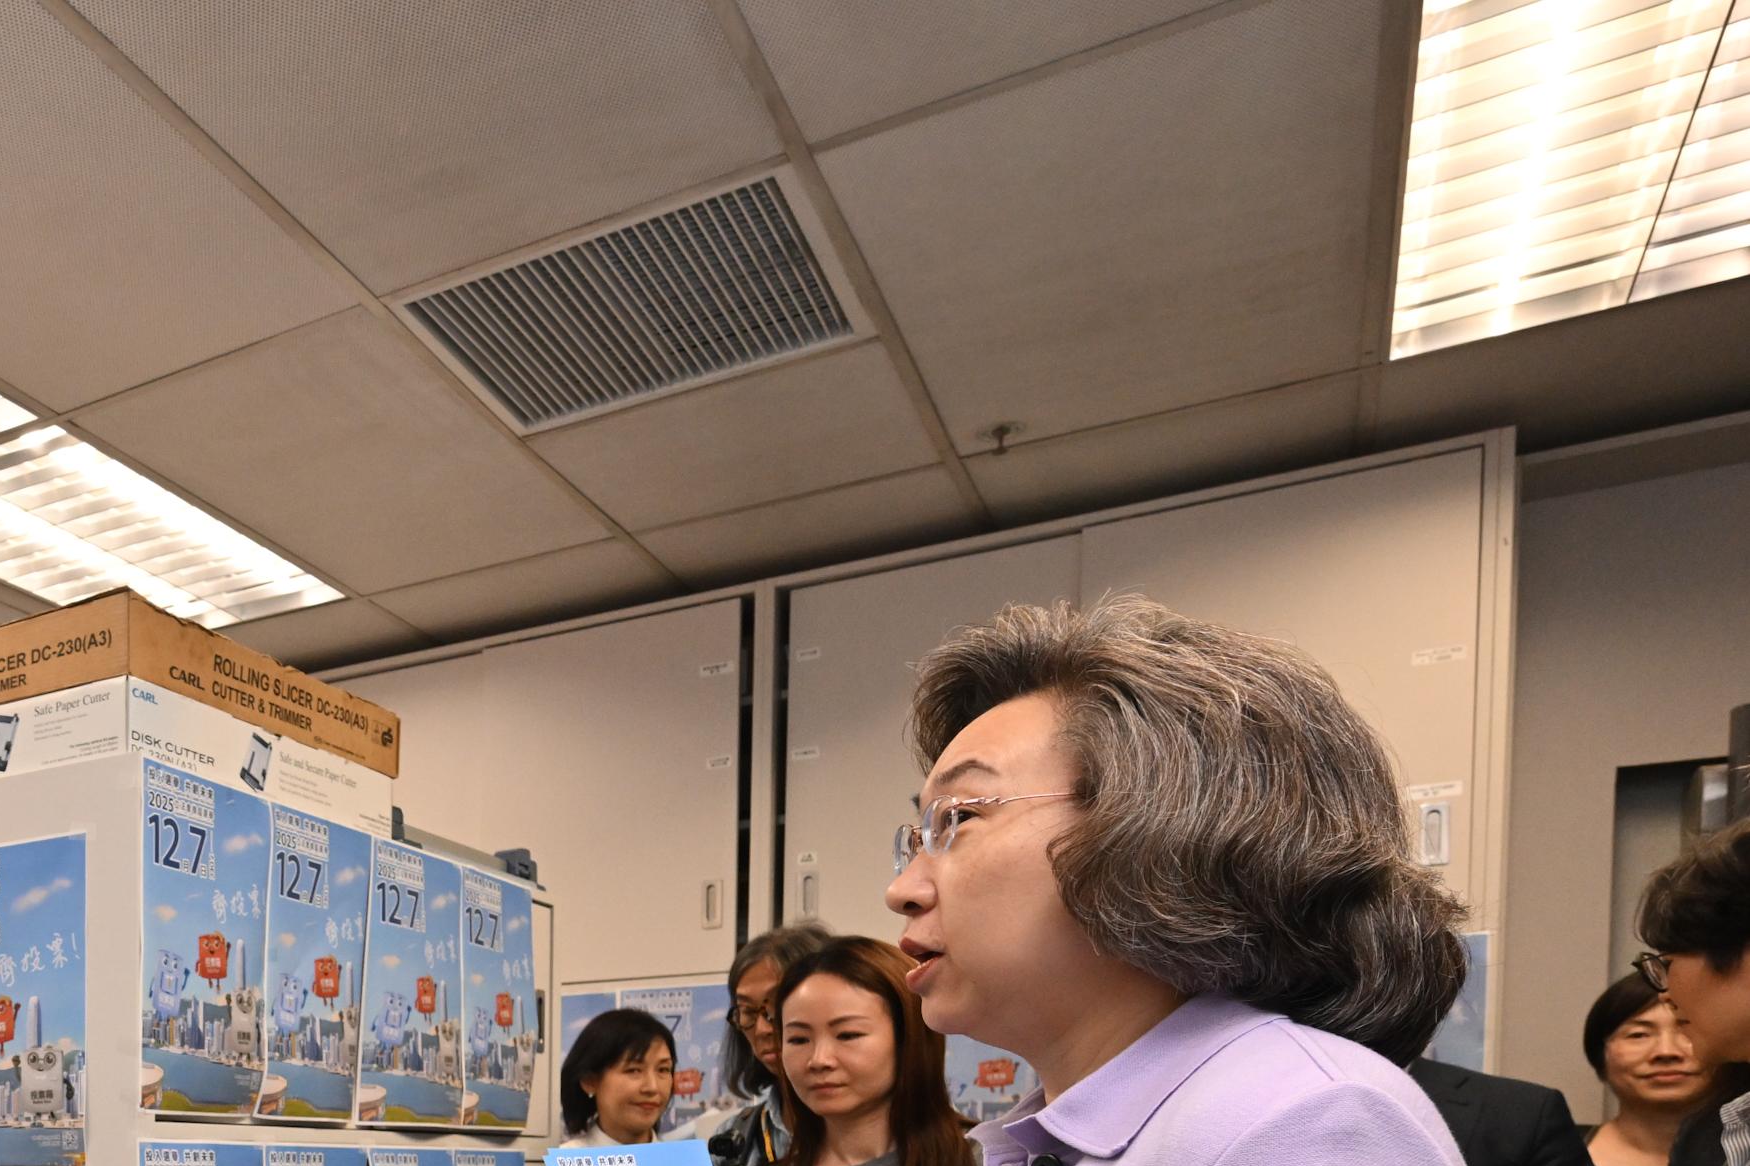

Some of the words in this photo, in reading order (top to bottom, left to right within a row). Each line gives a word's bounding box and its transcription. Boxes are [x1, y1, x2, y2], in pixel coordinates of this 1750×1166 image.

[31, 628, 113, 665] DC-230(A3)
[169, 665, 206, 691] CARL
[34, 702, 53, 718] Safe
[55, 698, 81, 713] Paper
[82, 692, 111, 706] Cutter
[131, 687, 158, 706] CARL
[212, 680, 255, 711] CUTTER
[257, 697, 265, 714] &
[269, 701, 312, 732] TRIMMER
[213, 654, 270, 692] ROLLING
[272, 678, 314, 711] SLICER
[316, 697, 369, 734] DC-230(A3)
[131, 730, 162, 750] DISK
[164, 742, 215, 768] CUTTER
[148, 791, 174, 813] 2025
[276, 831, 298, 849] 2025
